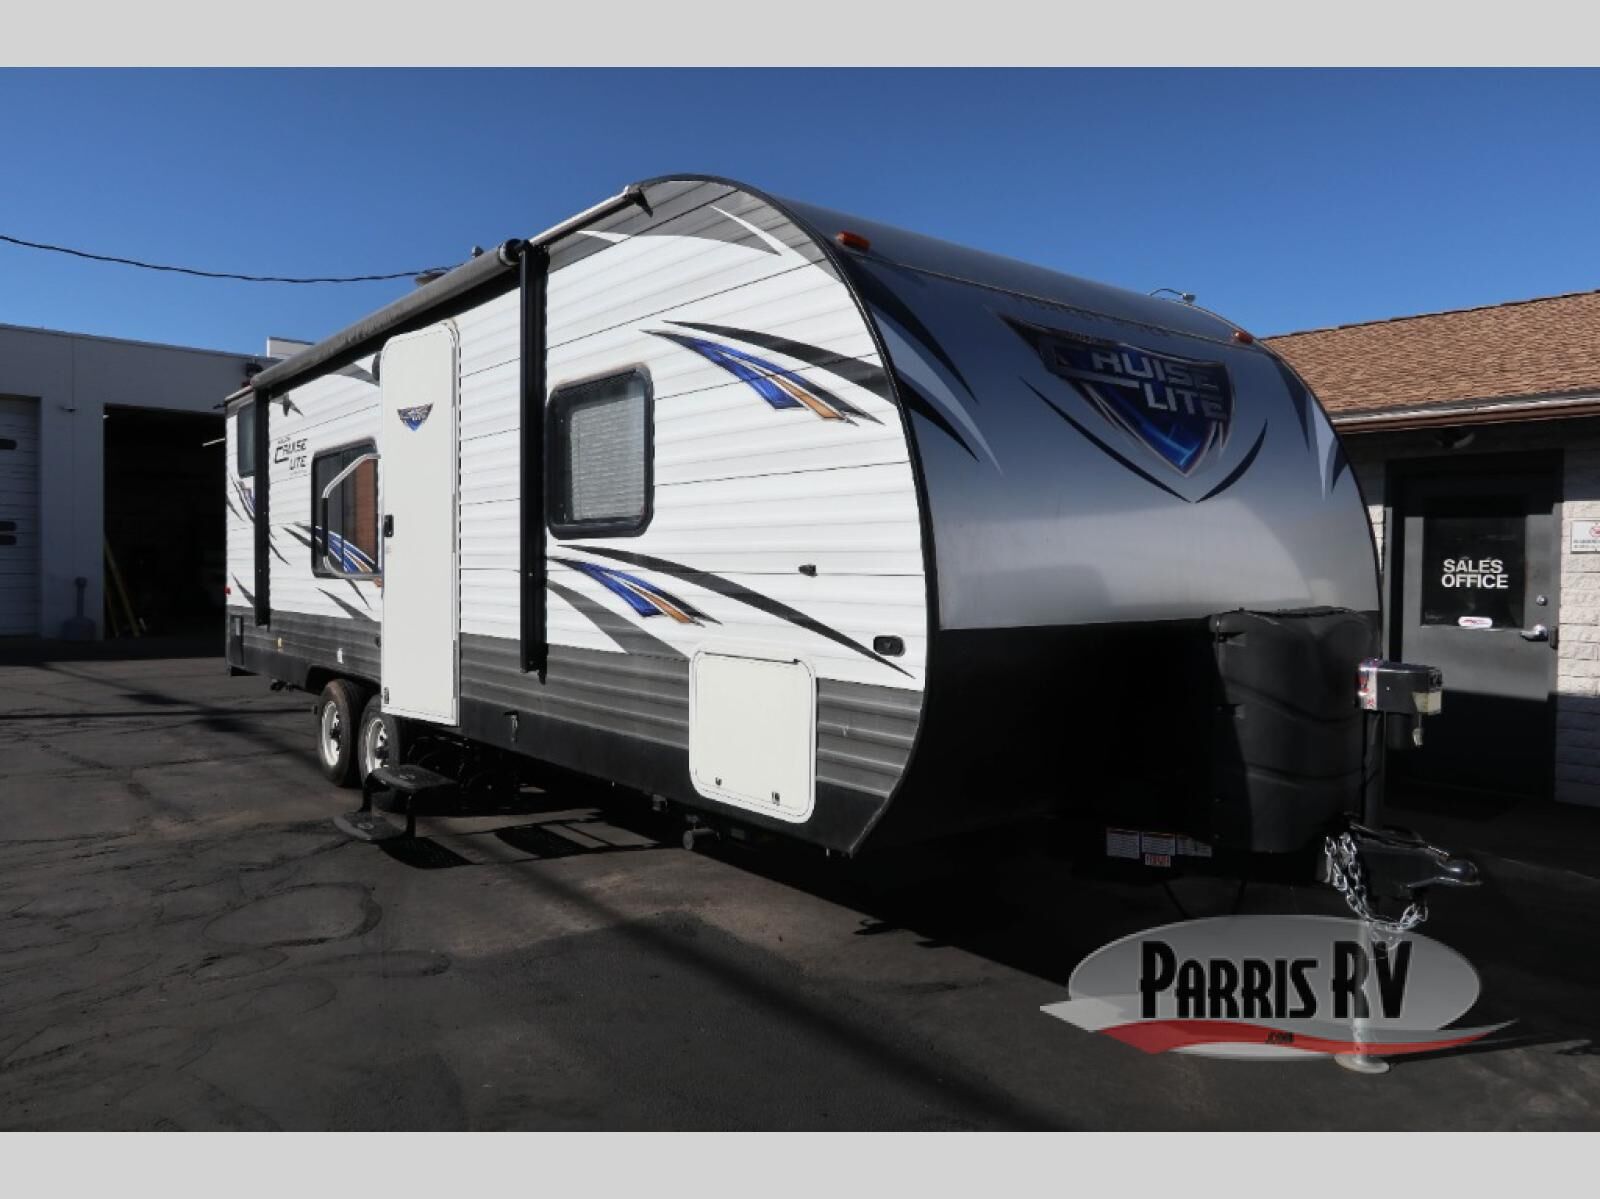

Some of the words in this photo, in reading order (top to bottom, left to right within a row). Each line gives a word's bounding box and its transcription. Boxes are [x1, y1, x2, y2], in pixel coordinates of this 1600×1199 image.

[1047, 345, 1220, 391] CRUISE
[1144, 382, 1227, 419] LITE
[1443, 558, 1504, 574] SALES
[1441, 574, 1509, 589] OFFICE
